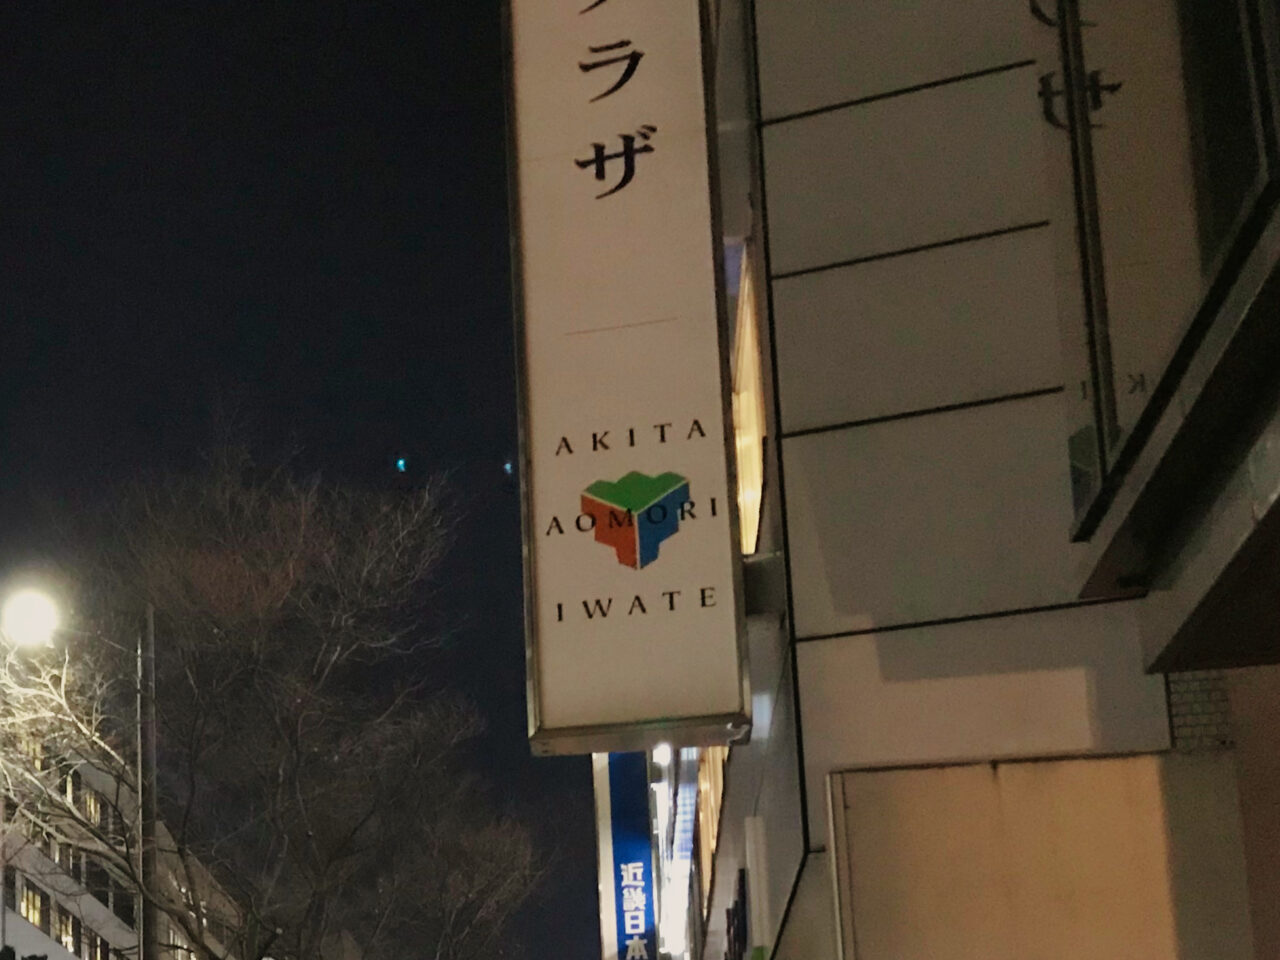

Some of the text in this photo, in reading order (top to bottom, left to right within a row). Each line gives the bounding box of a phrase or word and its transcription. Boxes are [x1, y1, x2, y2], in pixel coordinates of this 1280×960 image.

[574, 0, 658, 199] ラザ
[555, 419, 706, 456] AKITA
[546, 497, 718, 536] AOMORI
[556, 587, 717, 622] IWATE
